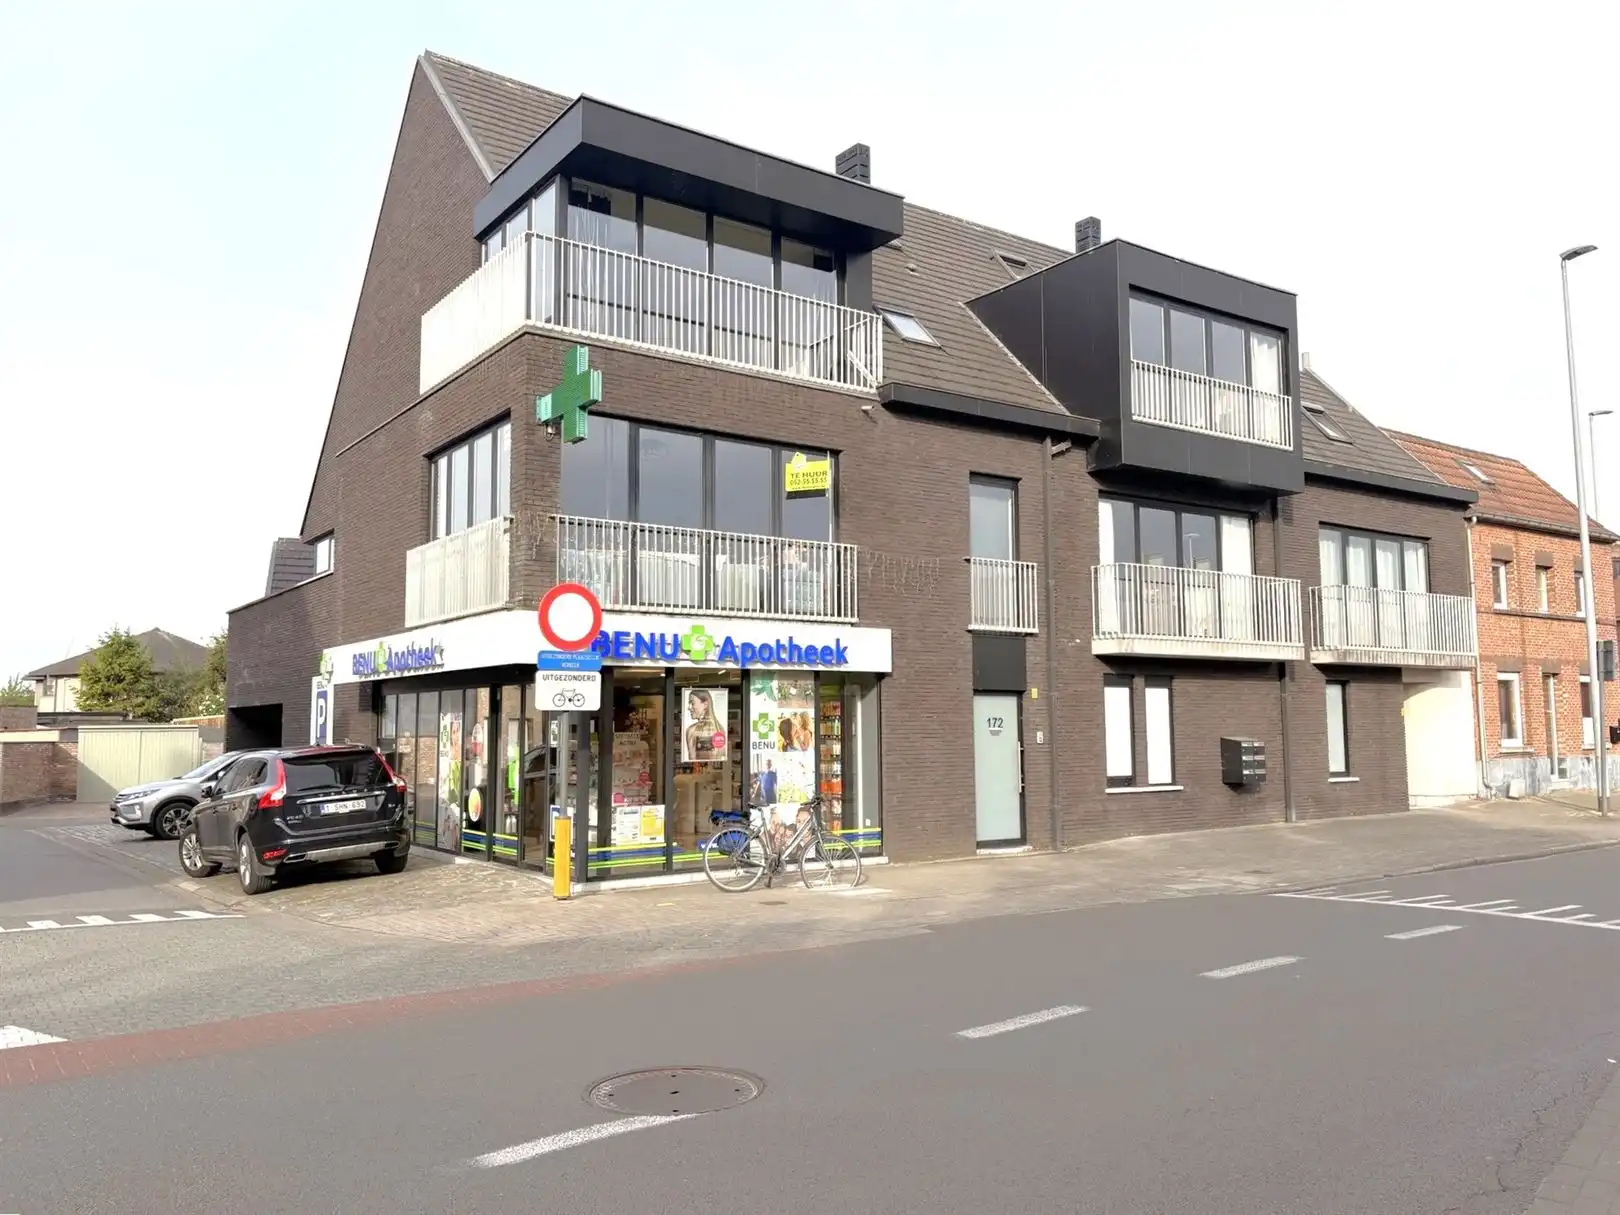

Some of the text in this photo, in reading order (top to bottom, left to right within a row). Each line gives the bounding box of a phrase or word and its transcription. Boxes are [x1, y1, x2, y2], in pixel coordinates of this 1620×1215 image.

[386, 643, 437, 673] Apotheek
[717, 635, 849, 668] Apotheek
[542, 674, 597, 682] UITGEZONDERD
[317, 698, 326, 738] P
[987, 717, 1004, 728] 172
[751, 741, 776, 750] BENU
